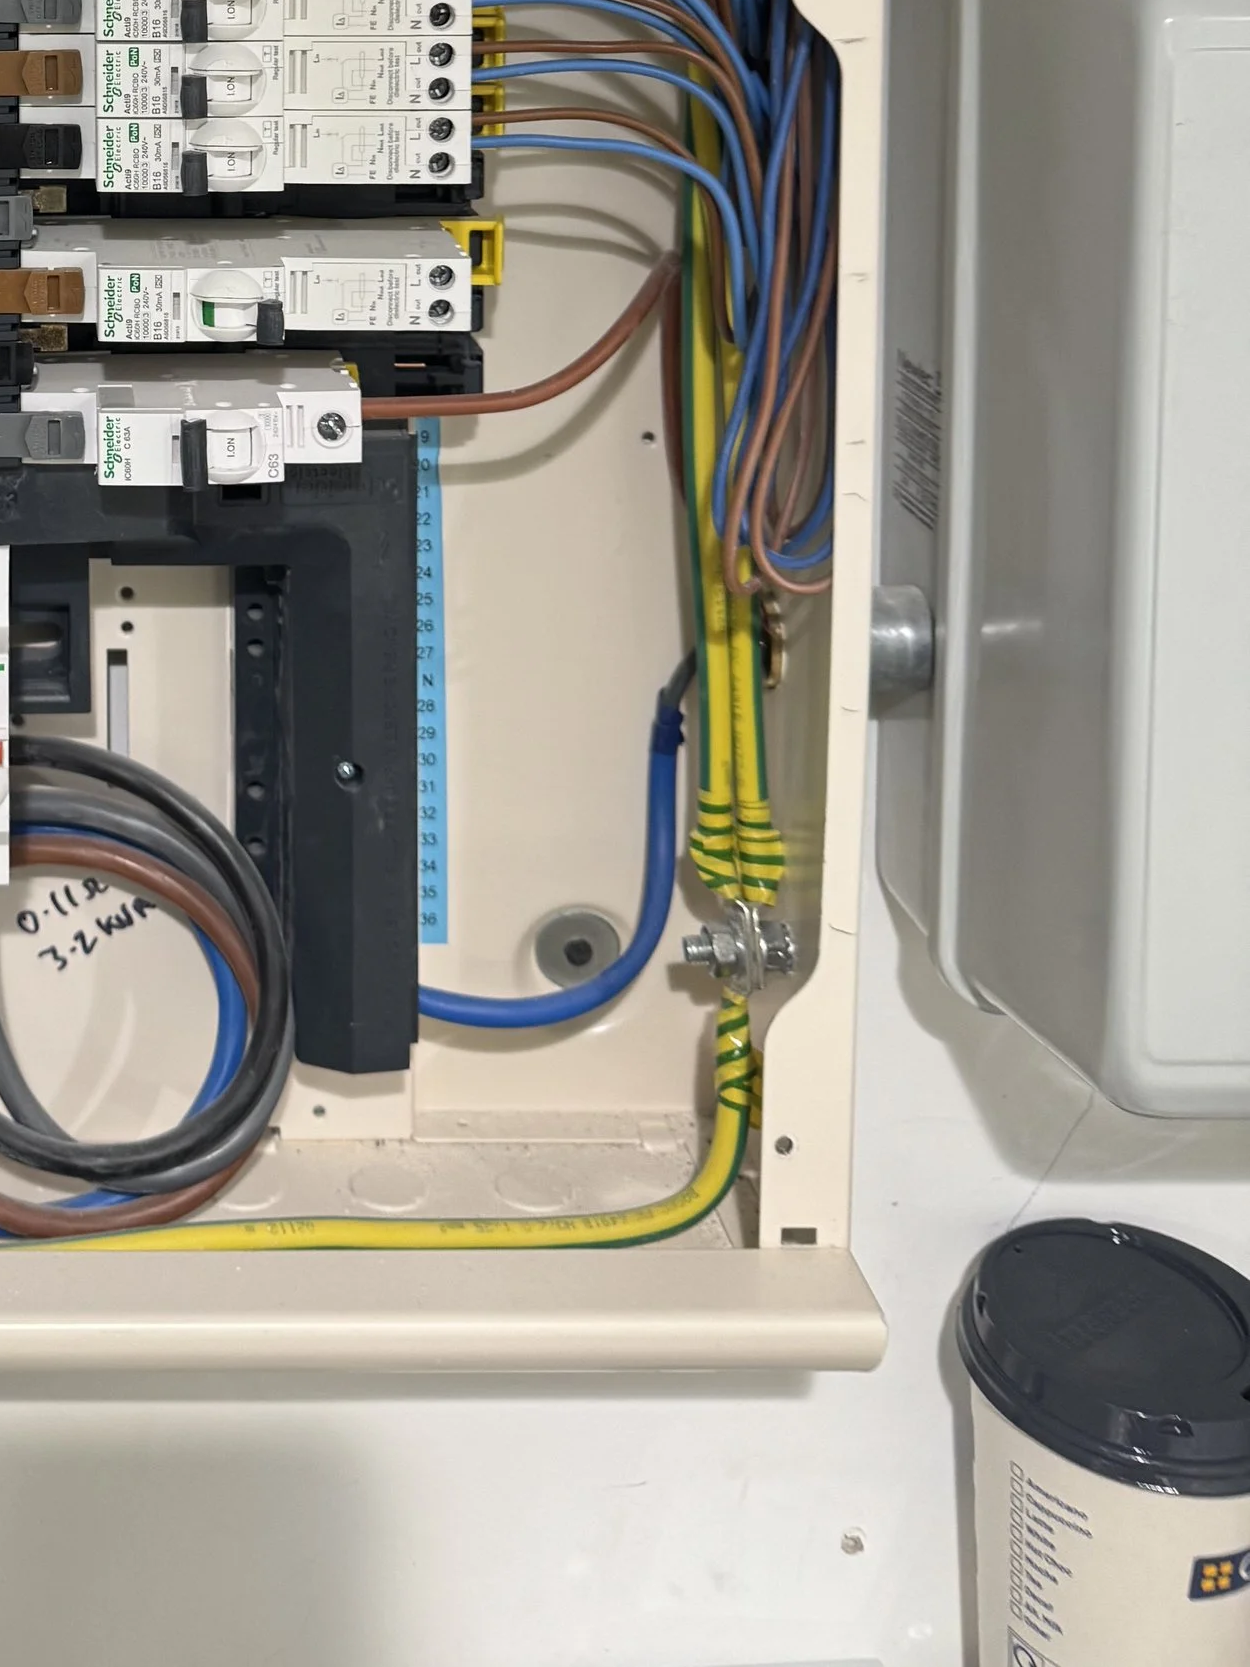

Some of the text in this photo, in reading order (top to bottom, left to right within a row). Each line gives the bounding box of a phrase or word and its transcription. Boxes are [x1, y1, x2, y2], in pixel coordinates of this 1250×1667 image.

[227, 0, 236, 20] I.ON
[153, 18, 161, 39] B16
[130, 49, 138, 65] PoN
[103, 50, 114, 113] Schneider
[227, 77, 236, 95] I.ON
[153, 94, 161, 114] B16
[130, 124, 138, 141] PoN
[103, 125, 114, 188] Schneider
[227, 152, 236, 171] I.ON
[153, 170, 161, 190] B16
[131, 274, 139, 291] PoN
[104, 275, 115, 338] Schneider
[154, 321, 162, 340] B16
[103, 416, 115, 480] Schneider
[227, 438, 235, 458] I.ON
[268, 454, 279, 478] C63
[417, 619, 433, 631] 26
[418, 647, 433, 659] 27
[423, 675, 433, 686] N
[418, 700, 434, 711] 28
[418, 727, 435, 739] 29
[419, 754, 436, 765] 30
[38, 930, 98, 971] 3.2
